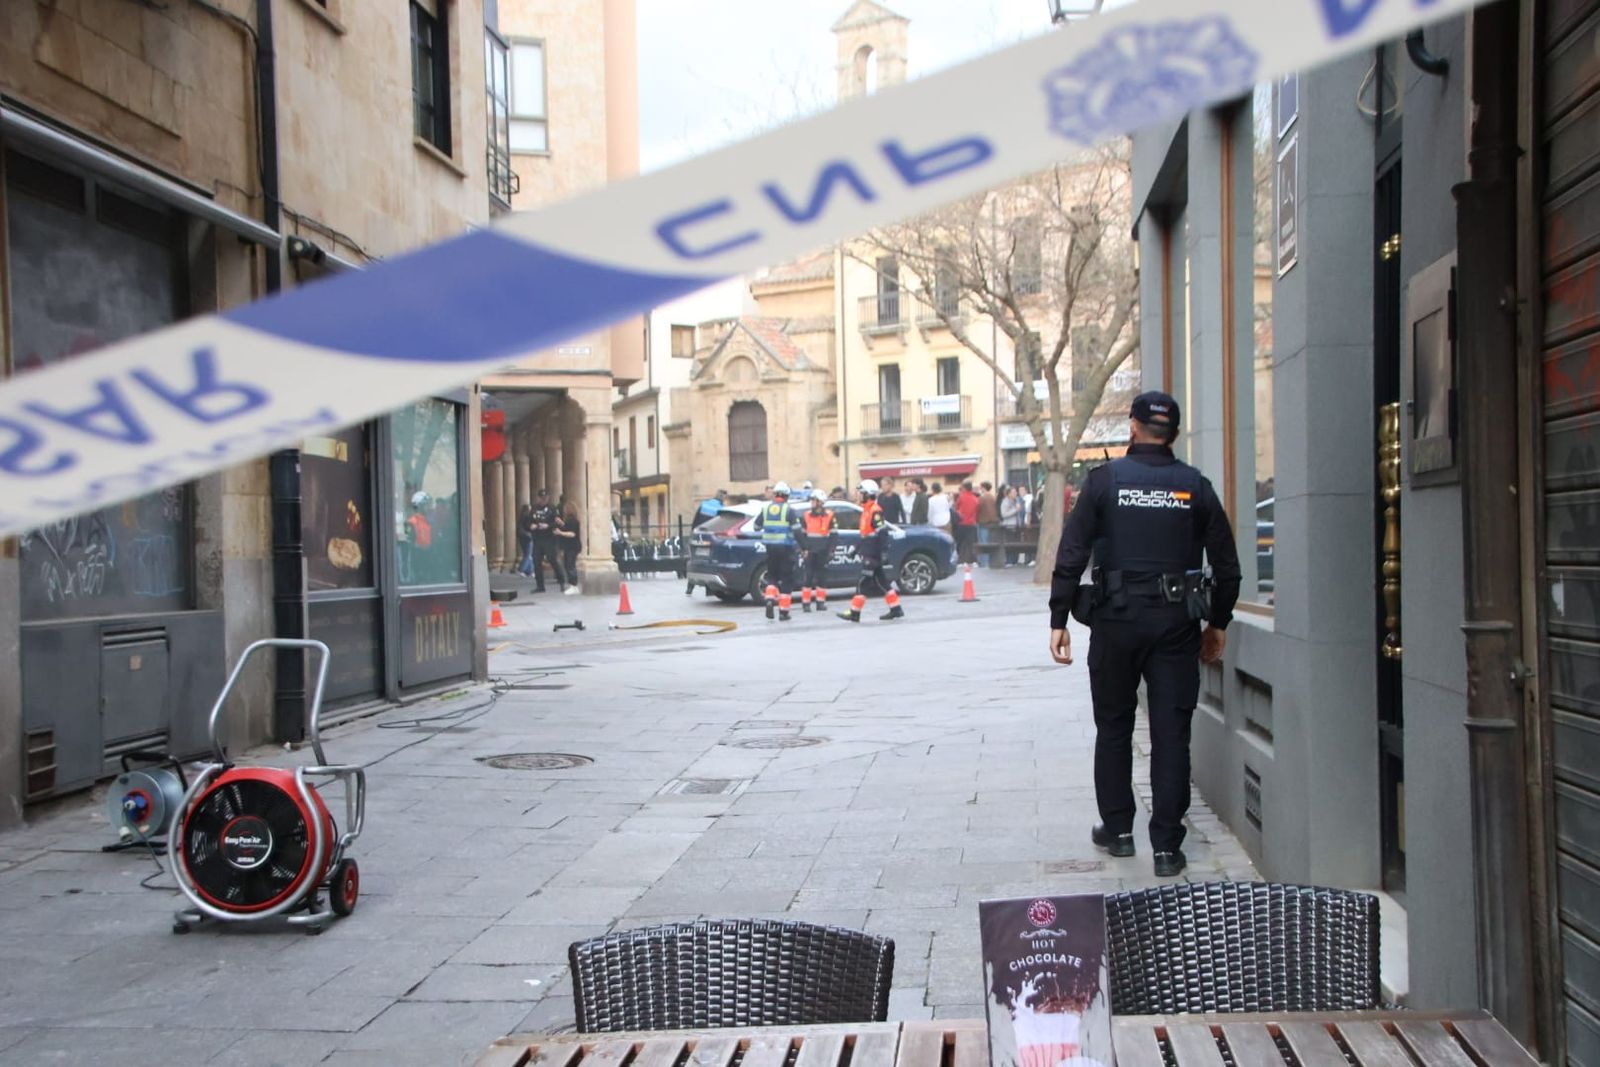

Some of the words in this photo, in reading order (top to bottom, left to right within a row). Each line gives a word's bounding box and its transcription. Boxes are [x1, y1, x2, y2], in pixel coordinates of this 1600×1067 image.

[1118, 489, 1176, 499] POLICIA
[1118, 498, 1191, 509] NACIONAL
[1031, 938, 1056, 950] HOT
[1009, 953, 1083, 972] CHOCOLATE
